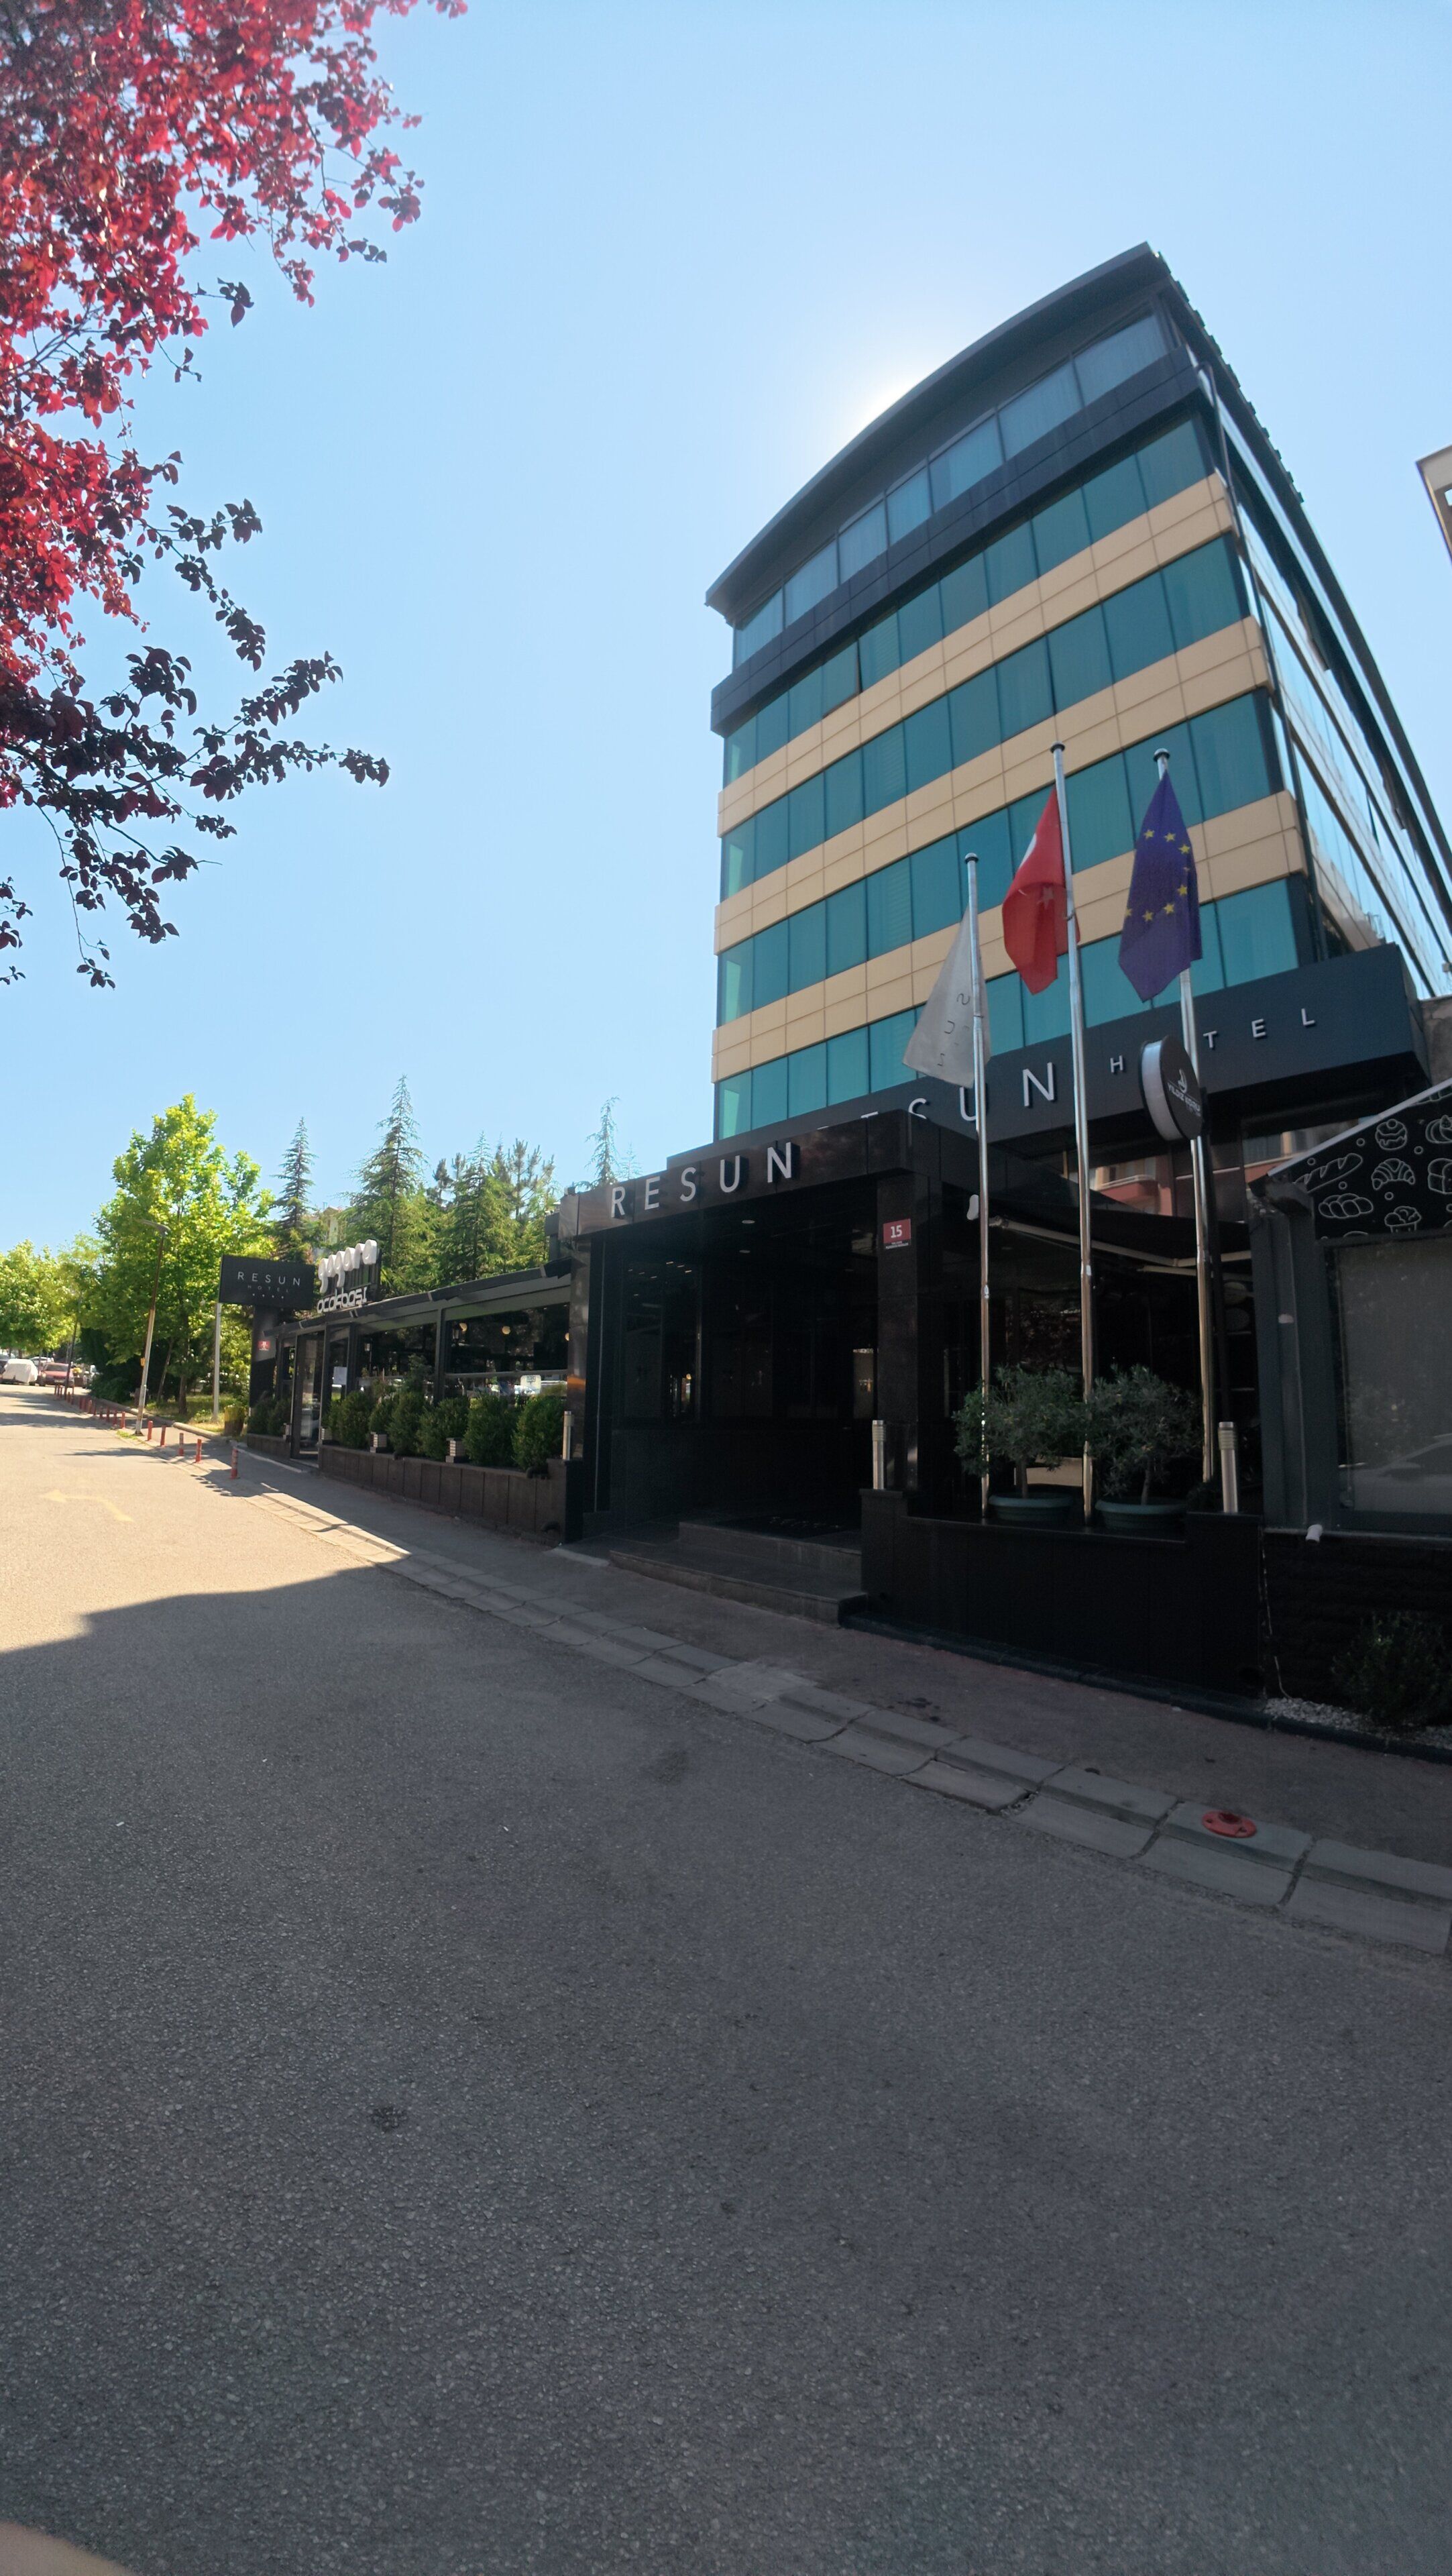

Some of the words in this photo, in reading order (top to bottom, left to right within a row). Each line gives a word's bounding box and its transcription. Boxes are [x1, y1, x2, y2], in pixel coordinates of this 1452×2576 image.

[1110, 1008, 1315, 1074] HTEL
[611, 1142, 792, 1218] RESUN
[890, 1224, 903, 1239] 15
[237, 1271, 300, 1286] RESUN
[247, 1285, 289, 1293] HOTEL
